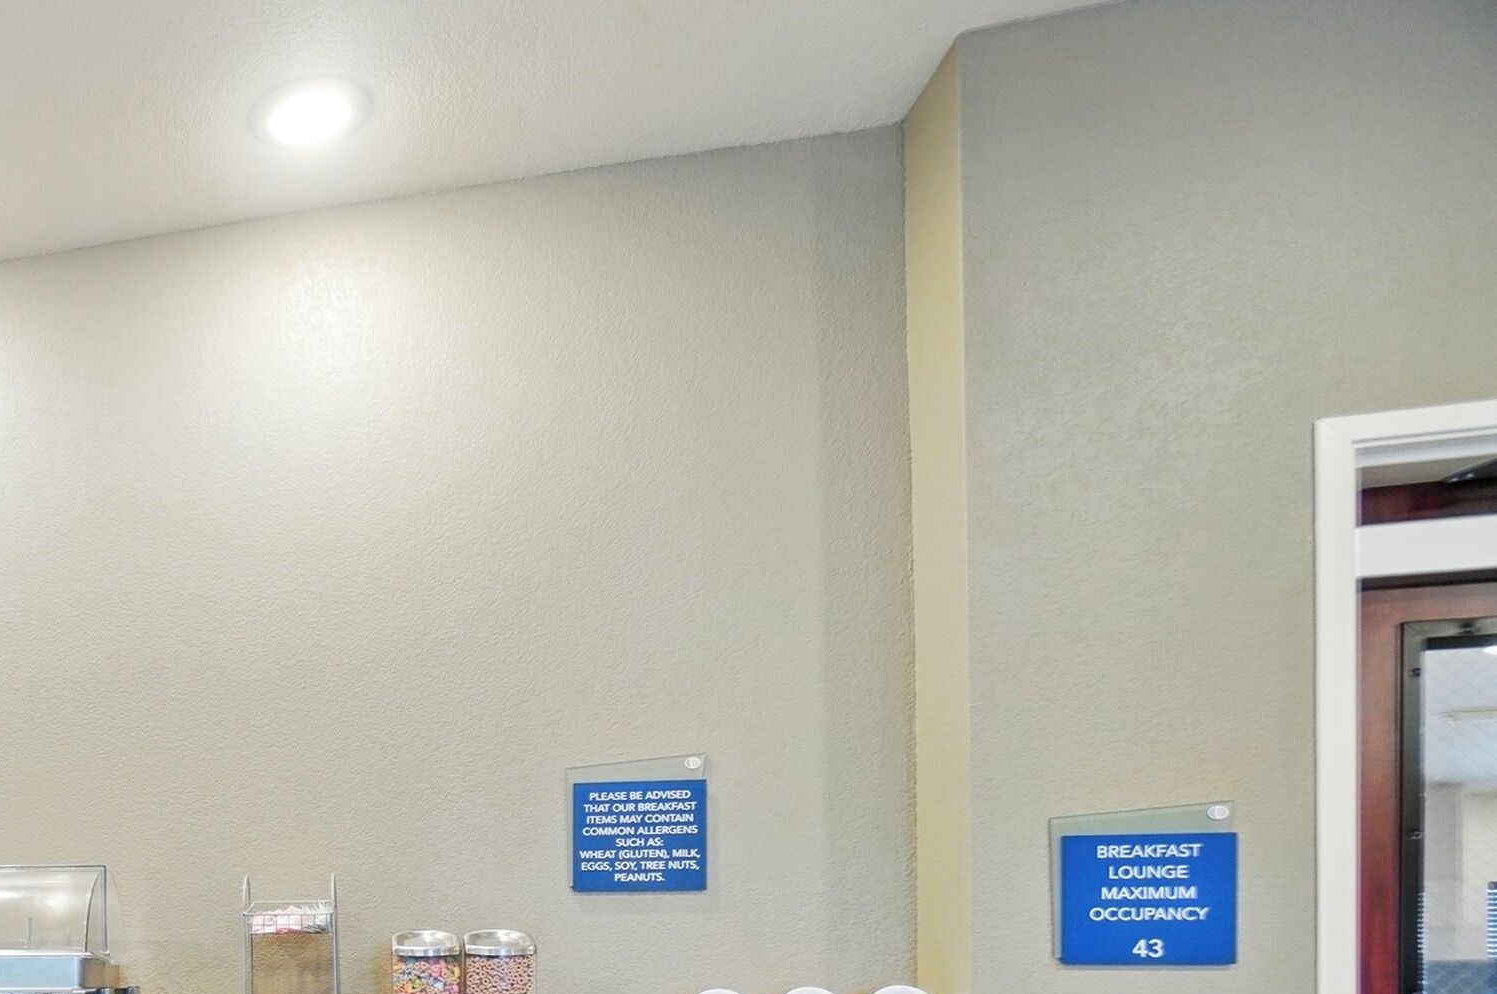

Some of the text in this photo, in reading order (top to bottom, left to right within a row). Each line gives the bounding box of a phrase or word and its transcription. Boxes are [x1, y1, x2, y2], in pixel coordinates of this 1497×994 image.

[589, 790, 691, 801] PLEASE BE ADVISED
[583, 801, 697, 813] THAT OUR BREAKFAST
[586, 813, 694, 824] ITEMS MAY CONTAIN
[582, 825, 698, 836] COMMON ALLERGENS
[615, 837, 664, 847] SUCH AS:
[579, 850, 616, 859] WHEAT
[672, 849, 701, 859] MILK,
[1097, 843, 1202, 858] BREAKFAST
[581, 859, 700, 871] EGGS, SOY, TREE NUTS,
[614, 872, 665, 882] PEANUTS.
[1108, 865, 1189, 879] LOUNGE
[1101, 886, 1197, 900] MAXIMUM
[1089, 906, 1209, 920] OCCUPANCY
[1131, 939, 1165, 958] 43
